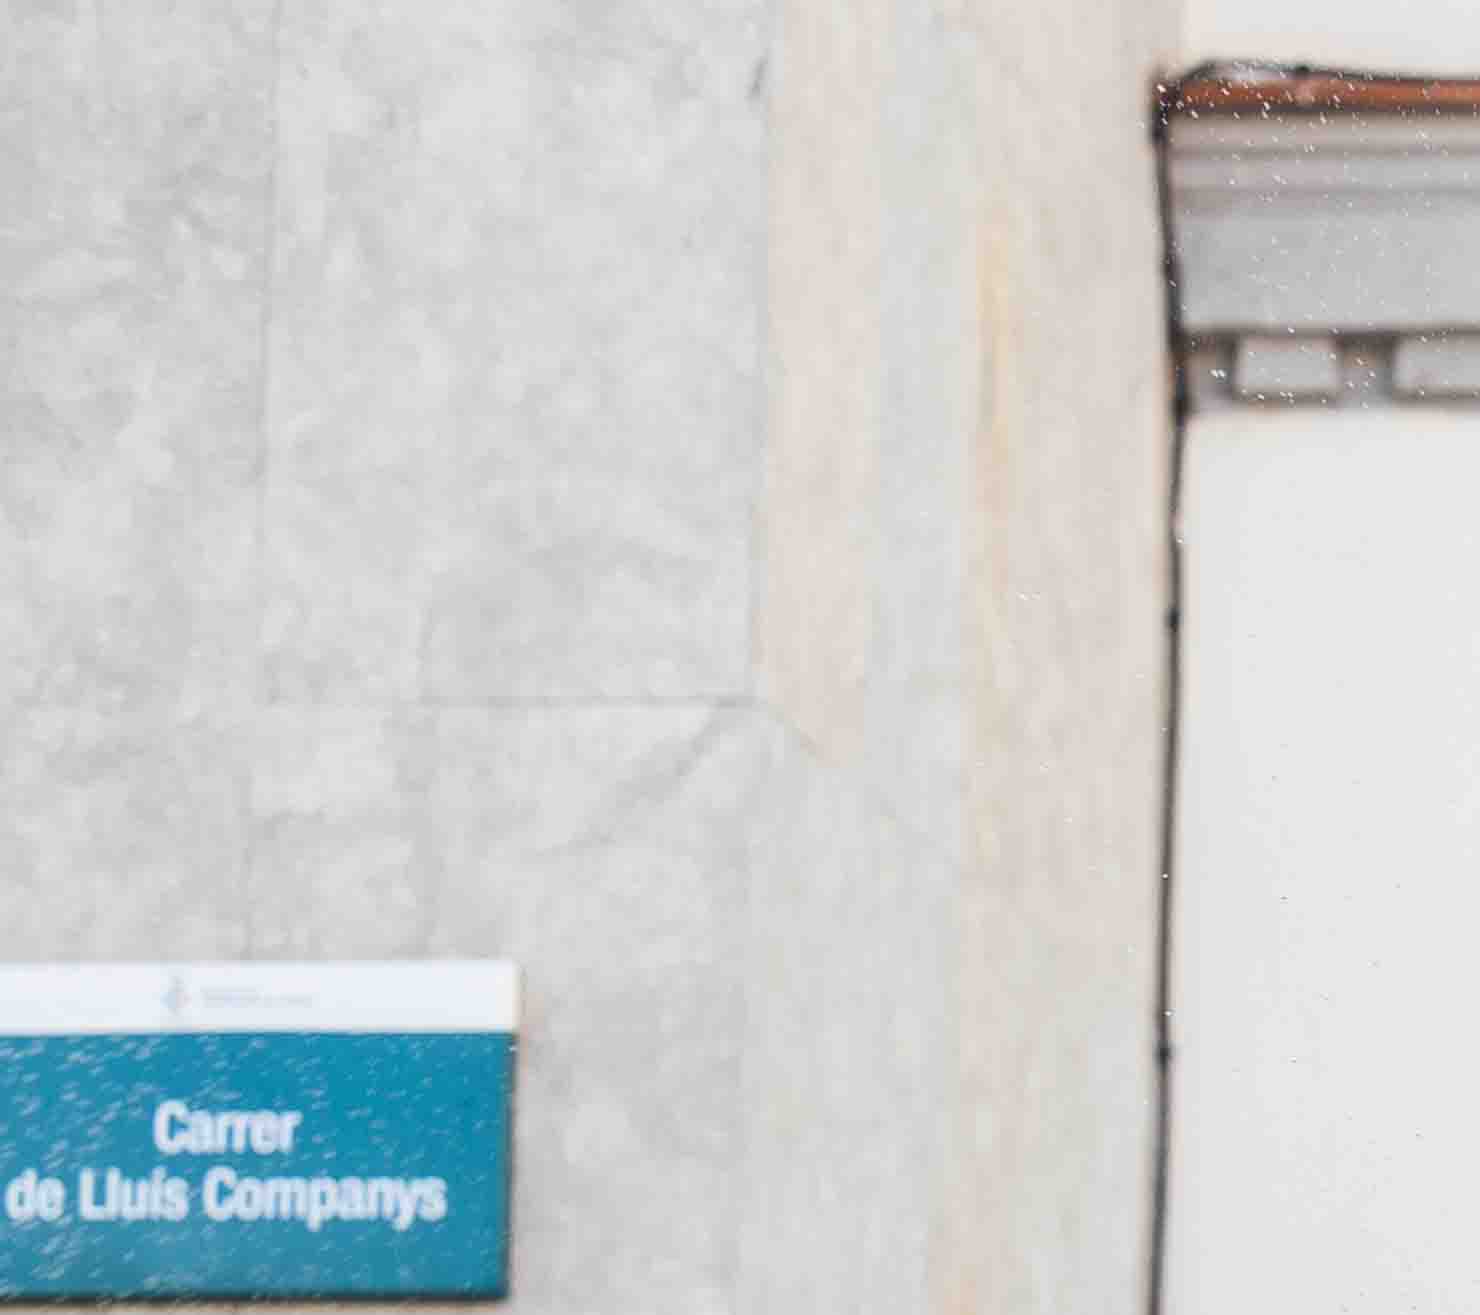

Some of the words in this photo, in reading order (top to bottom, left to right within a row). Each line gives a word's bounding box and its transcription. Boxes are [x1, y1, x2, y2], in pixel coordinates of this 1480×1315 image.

[153, 1099, 303, 1153] Carrer
[4, 1167, 66, 1222] de
[79, 1166, 189, 1222] Lluís
[203, 1166, 448, 1231] Companys
